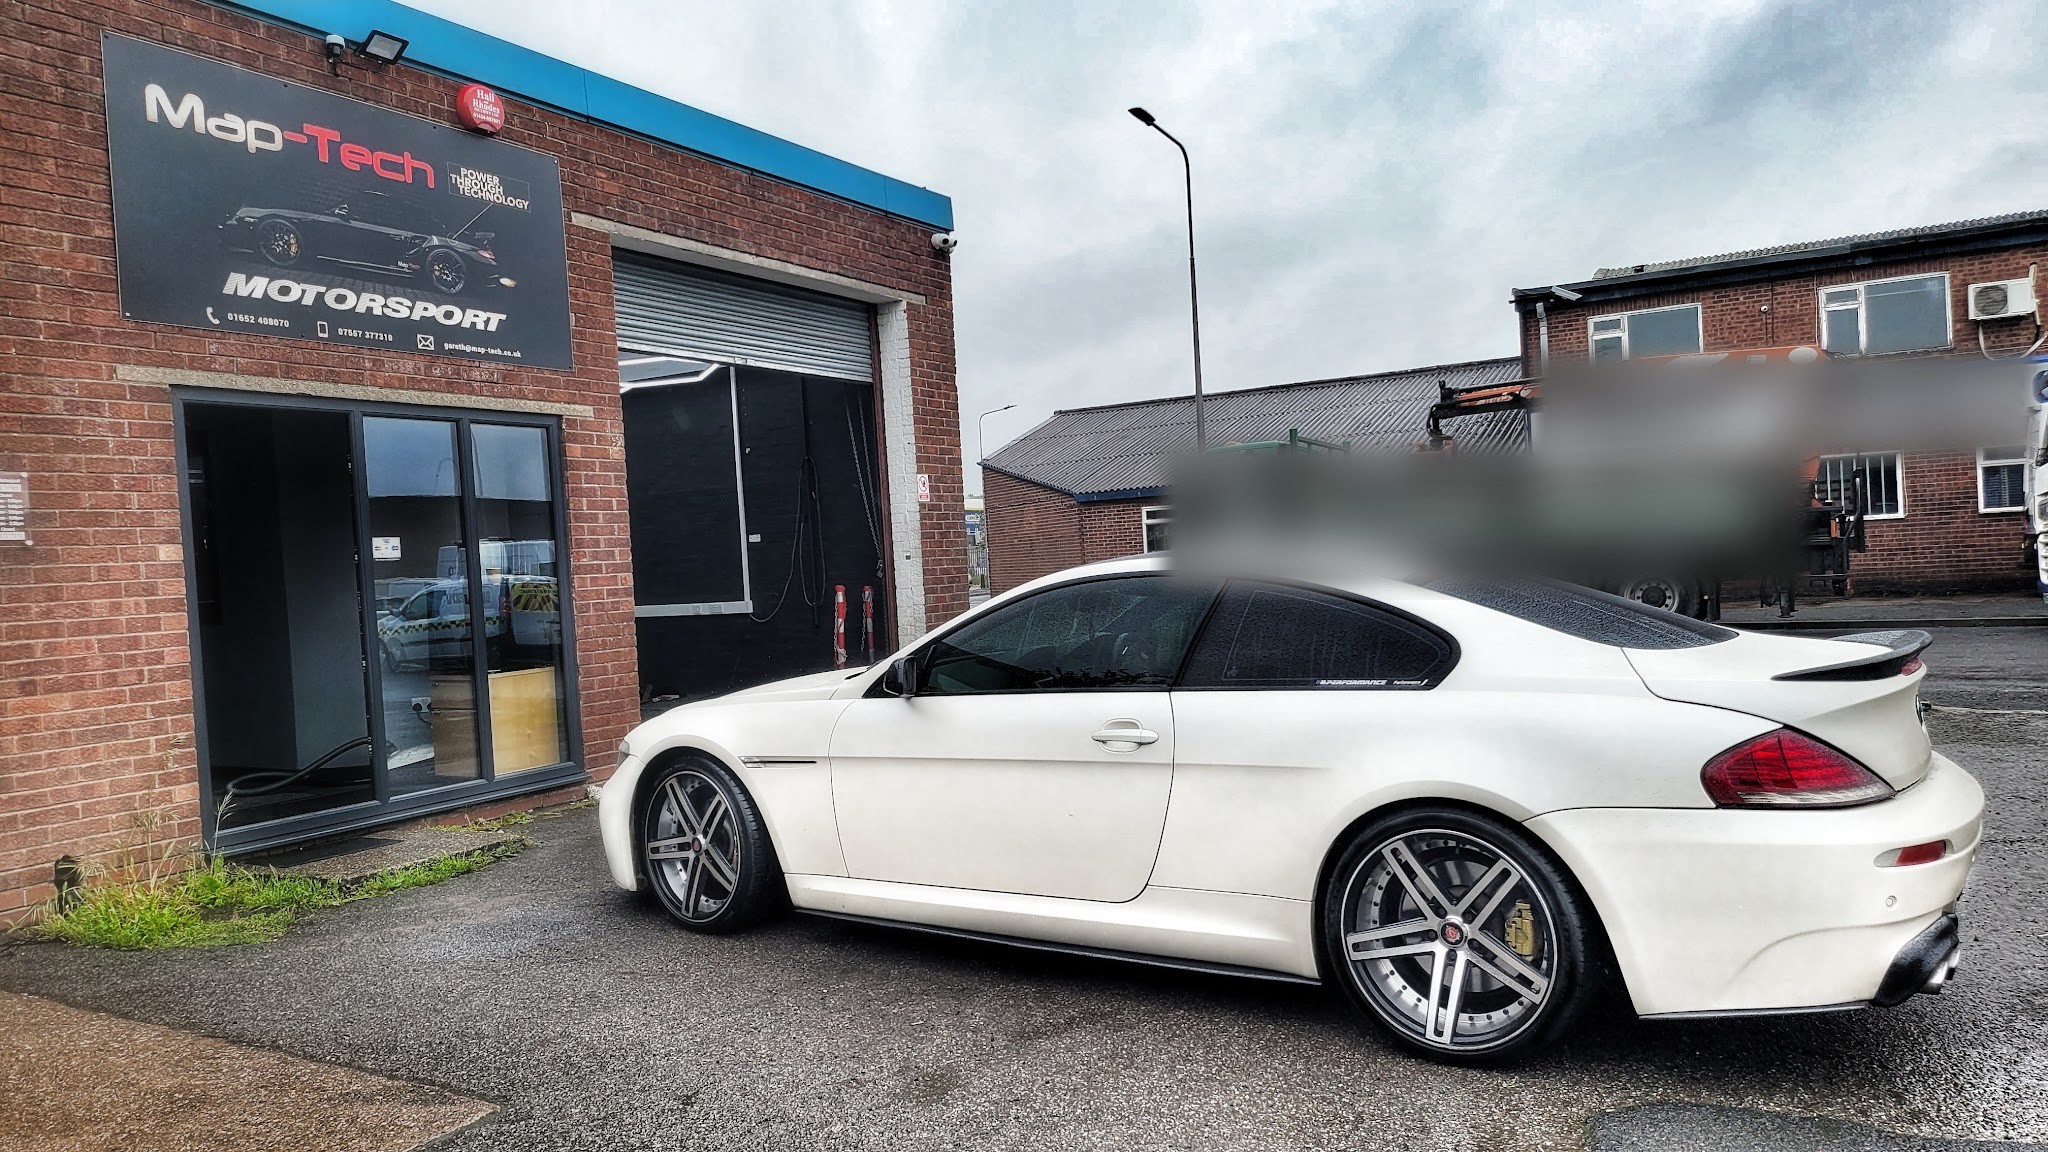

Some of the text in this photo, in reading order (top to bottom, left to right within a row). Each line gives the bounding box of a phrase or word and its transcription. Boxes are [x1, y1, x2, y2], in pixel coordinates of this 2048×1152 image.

[476, 89, 495, 102] Hall
[472, 98, 500, 114] Rhodes
[144, 84, 435, 189] Map-Tech
[450, 173, 503, 195] THROUGH
[460, 167, 500, 186] POWER
[458, 185, 529, 210] TECHNOLOGY
[222, 271, 507, 332] MOTORSPORT
[227, 312, 290, 328] 01652 408070
[338, 327, 393, 342] 07557 377310
[443, 342, 522, 358] gareth@map-tech.co.uk
